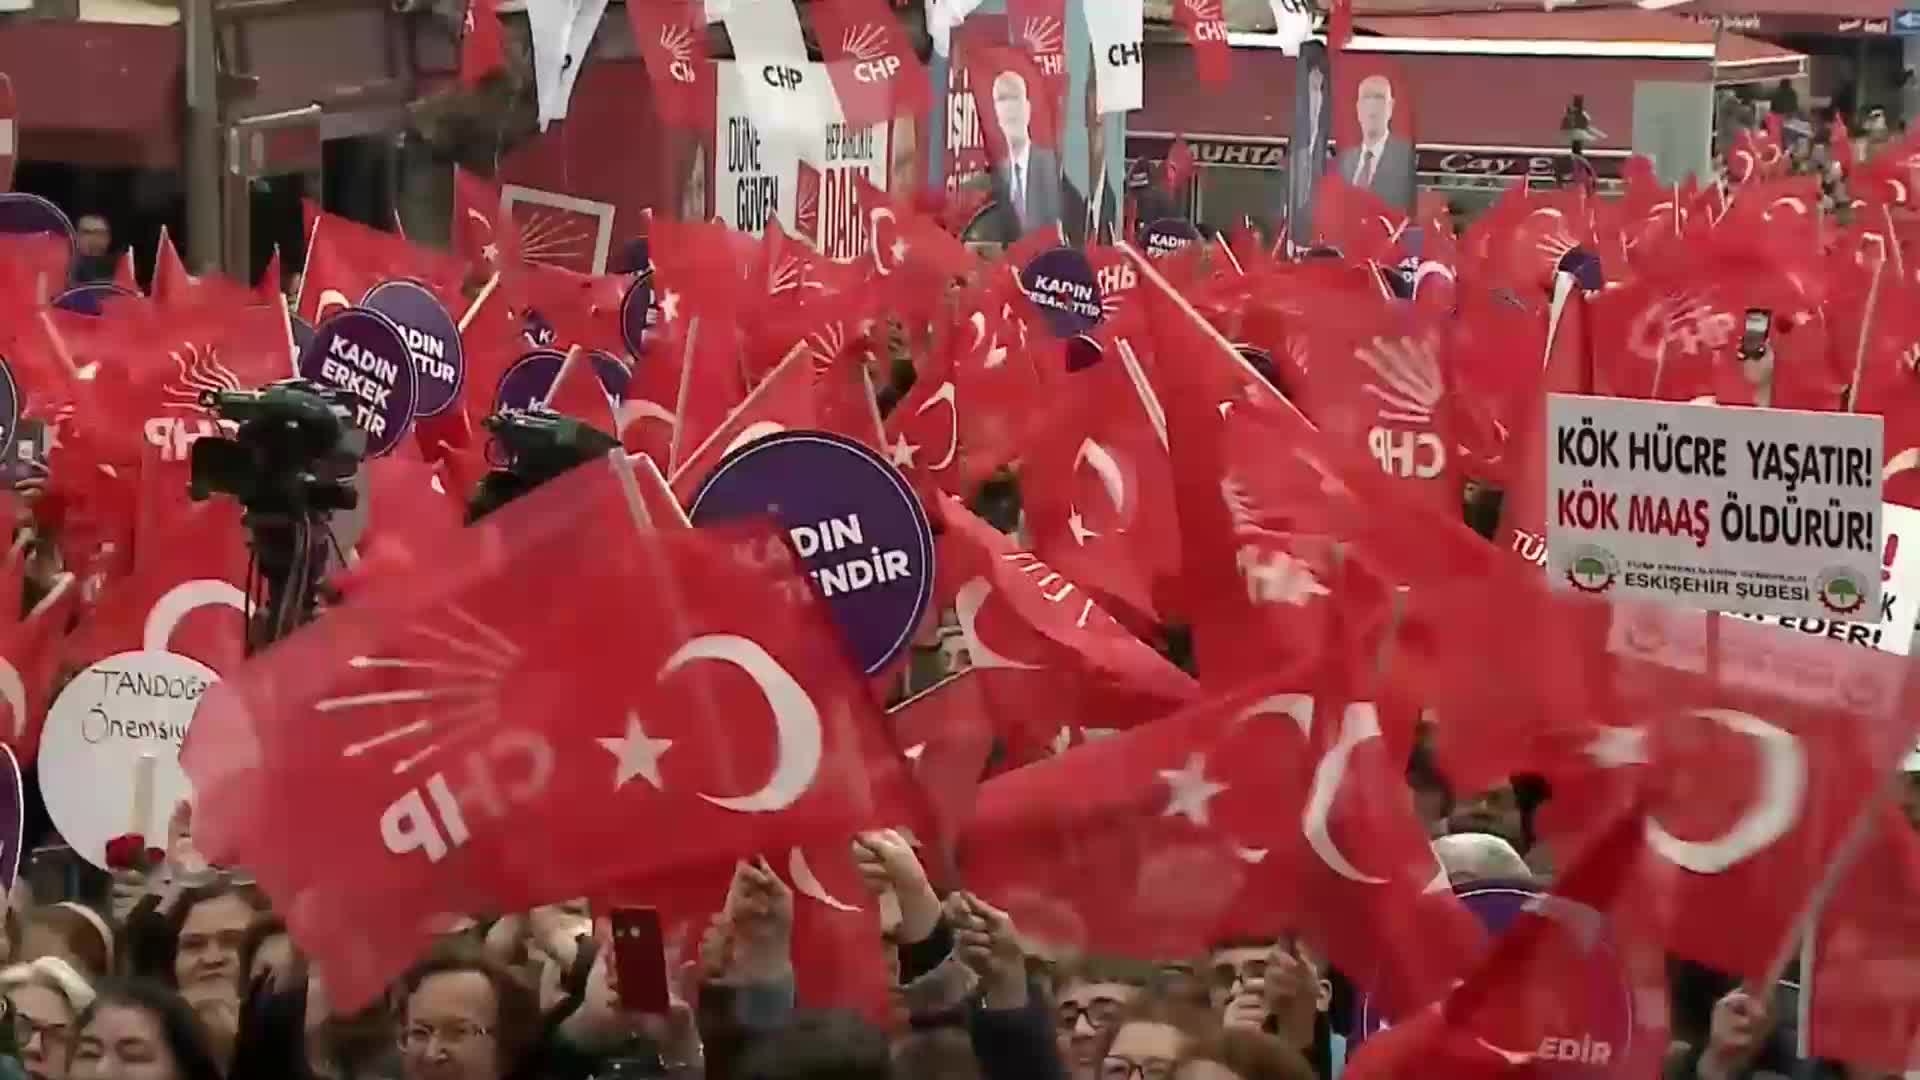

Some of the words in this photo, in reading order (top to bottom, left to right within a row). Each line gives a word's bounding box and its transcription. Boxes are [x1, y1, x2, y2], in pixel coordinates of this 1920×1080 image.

[762, 65, 803, 91] CHP
[853, 55, 901, 82] CHP
[1108, 43, 1143, 67] CH
[321, 358, 392, 410] ERKEK
[329, 333, 398, 385] KADIN
[1558, 416, 1619, 468] KÖK
[1629, 422, 1727, 476] HÜCRE
[1746, 440, 1872, 491] YAŞATIR!
[1558, 479, 1619, 530] KÖK
[1628, 494, 1710, 548] MAAŞ
[1720, 491, 1872, 552] ÖLDÜRÜR!
